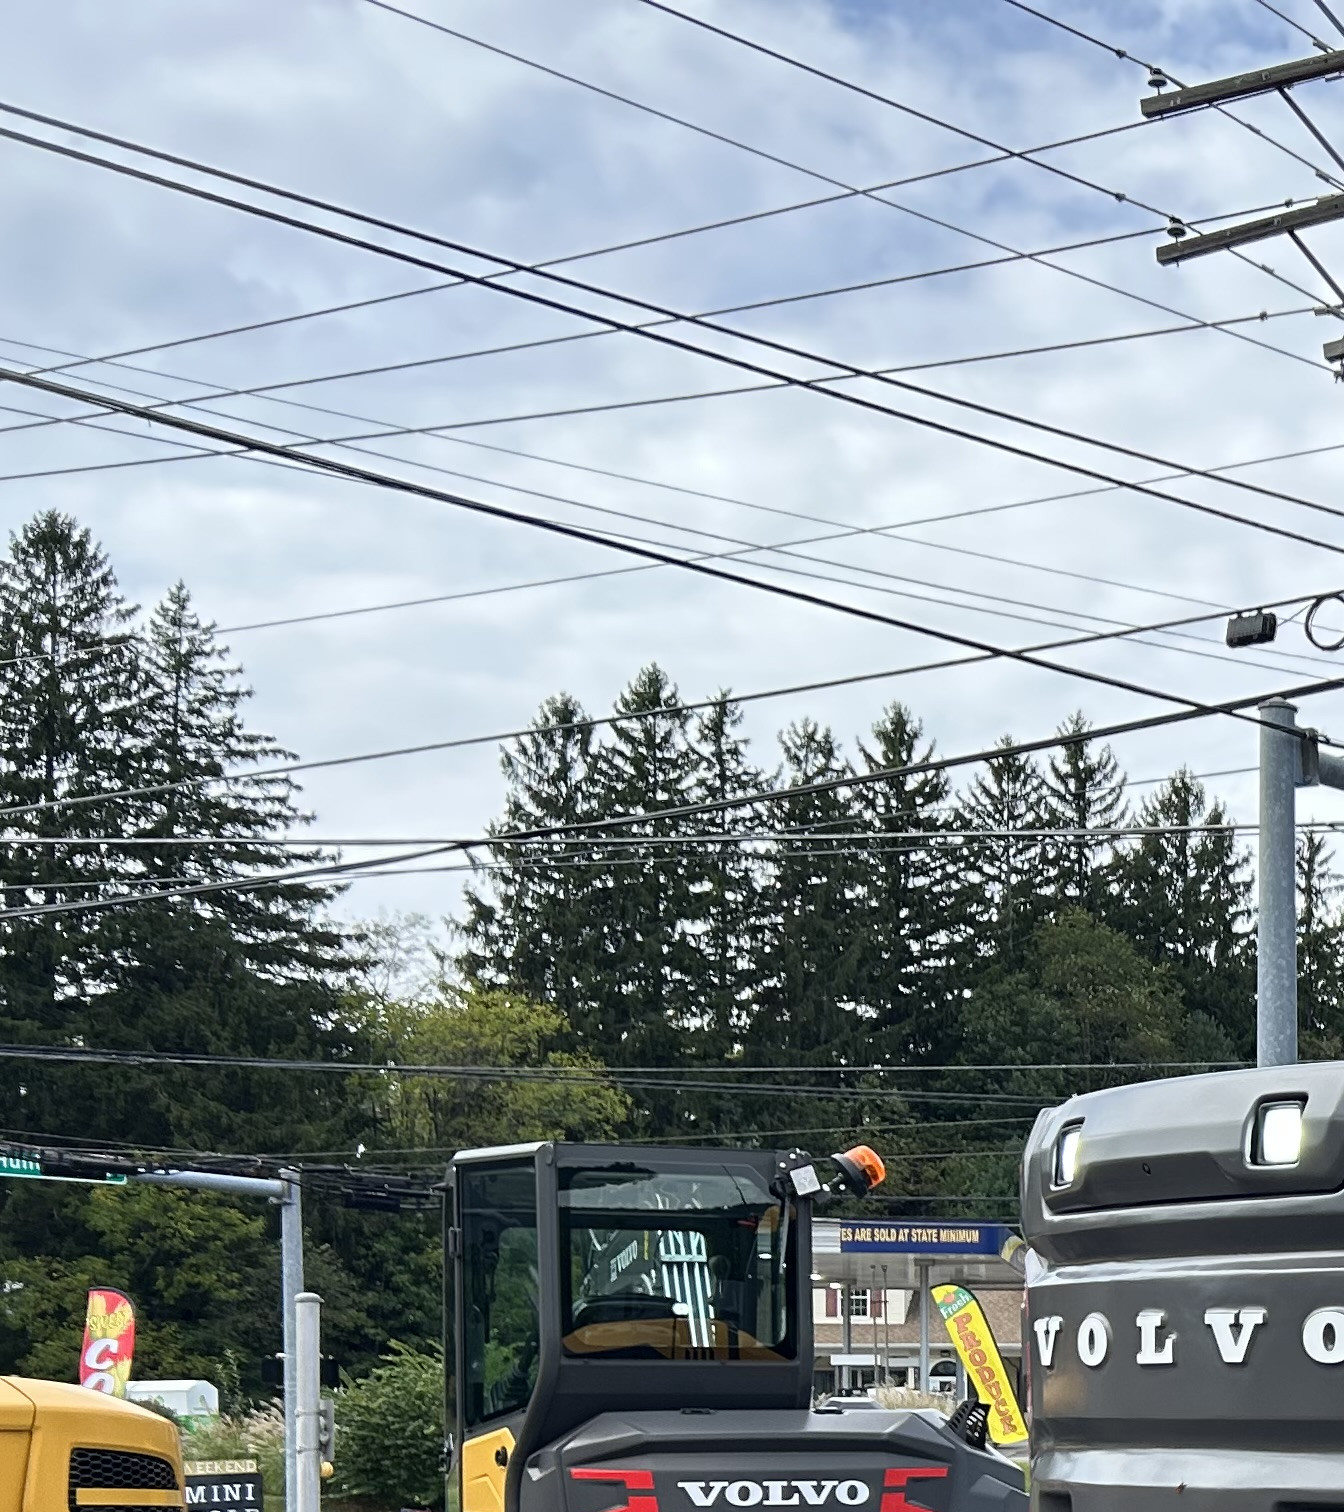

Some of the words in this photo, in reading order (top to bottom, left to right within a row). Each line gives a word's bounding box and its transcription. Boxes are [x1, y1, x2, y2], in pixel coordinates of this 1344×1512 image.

[854, 1228, 872, 1242] ARE
[874, 1228, 897, 1242] SOLD
[898, 1228, 910, 1242] AT
[911, 1228, 938, 1243] STATE
[940, 1228, 979, 1243] MINIMUM
[940, 1292, 972, 1319] Fresh
[185, 1483, 255, 1504] MINI
[677, 1480, 870, 1507] VOLVO
